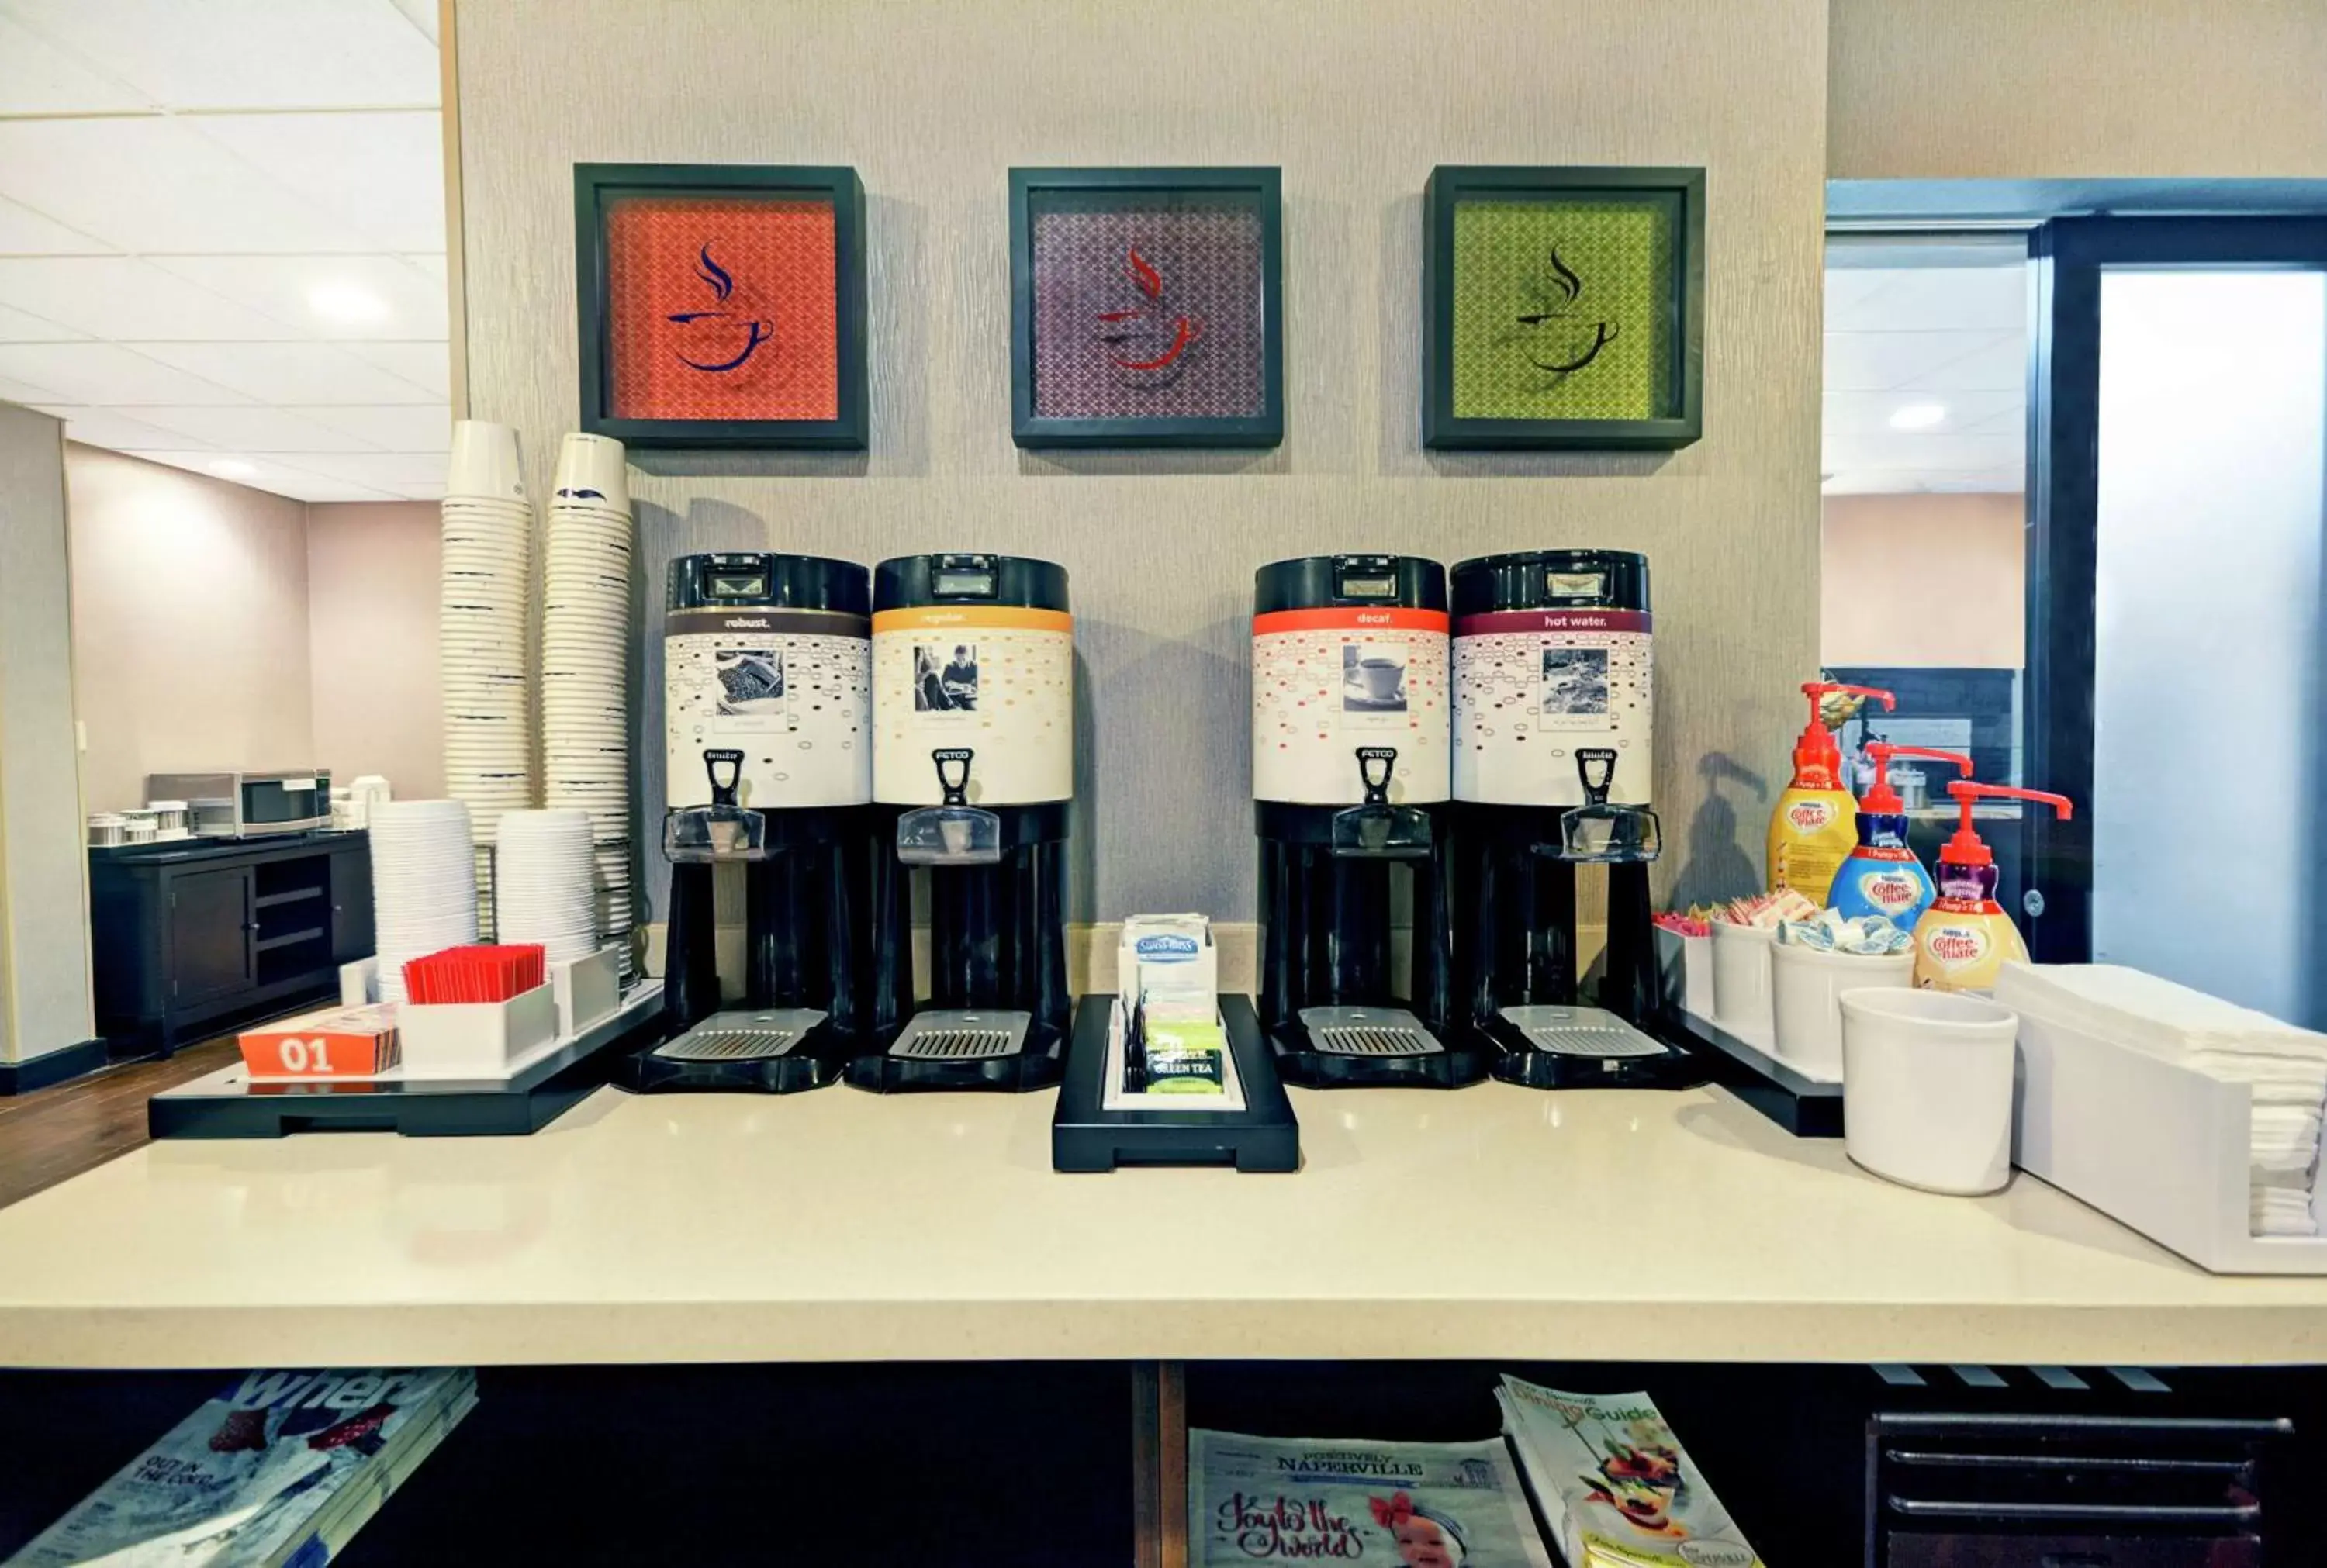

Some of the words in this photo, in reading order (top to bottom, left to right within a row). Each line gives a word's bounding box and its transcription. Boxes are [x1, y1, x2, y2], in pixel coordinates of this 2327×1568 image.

[724, 617, 770, 628] robust.
[1544, 616, 1567, 627] hot
[1570, 616, 1606, 627] water.
[1941, 948, 1979, 960] mate
[279, 1038, 334, 1072] 01
[1153, 1062, 1190, 1074] GREEN
[1191, 1062, 1213, 1074] TEA
[1585, 1405, 1658, 1422] Guide
[146, 1455, 181, 1471] OUT
[1276, 1456, 1423, 1476] NAPERVILLE
[1308, 1498, 1351, 1535] the
